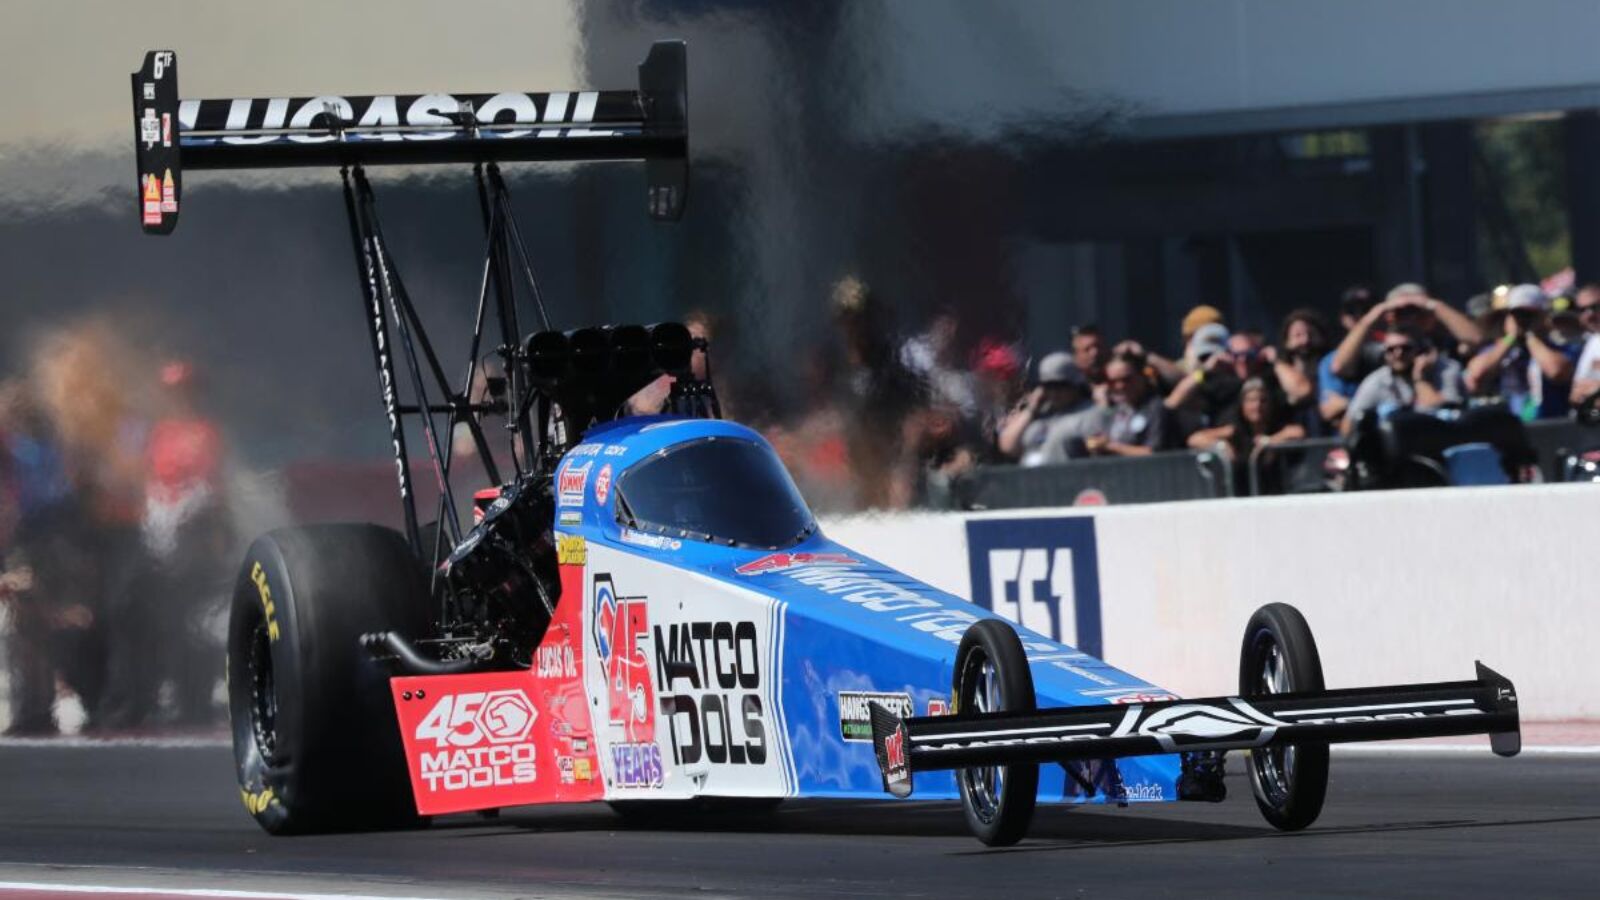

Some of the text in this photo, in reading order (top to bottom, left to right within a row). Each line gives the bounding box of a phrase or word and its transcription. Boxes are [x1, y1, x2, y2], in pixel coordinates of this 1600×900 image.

[178, 94, 460, 145] LUCAS
[477, 91, 615, 138] OIL
[537, 647, 562, 678] LUCAS
[653, 621, 760, 692] MATCO
[420, 743, 536, 773] MATCO
[610, 742, 664, 788] YEARS
[420, 764, 537, 792] TOOLS
